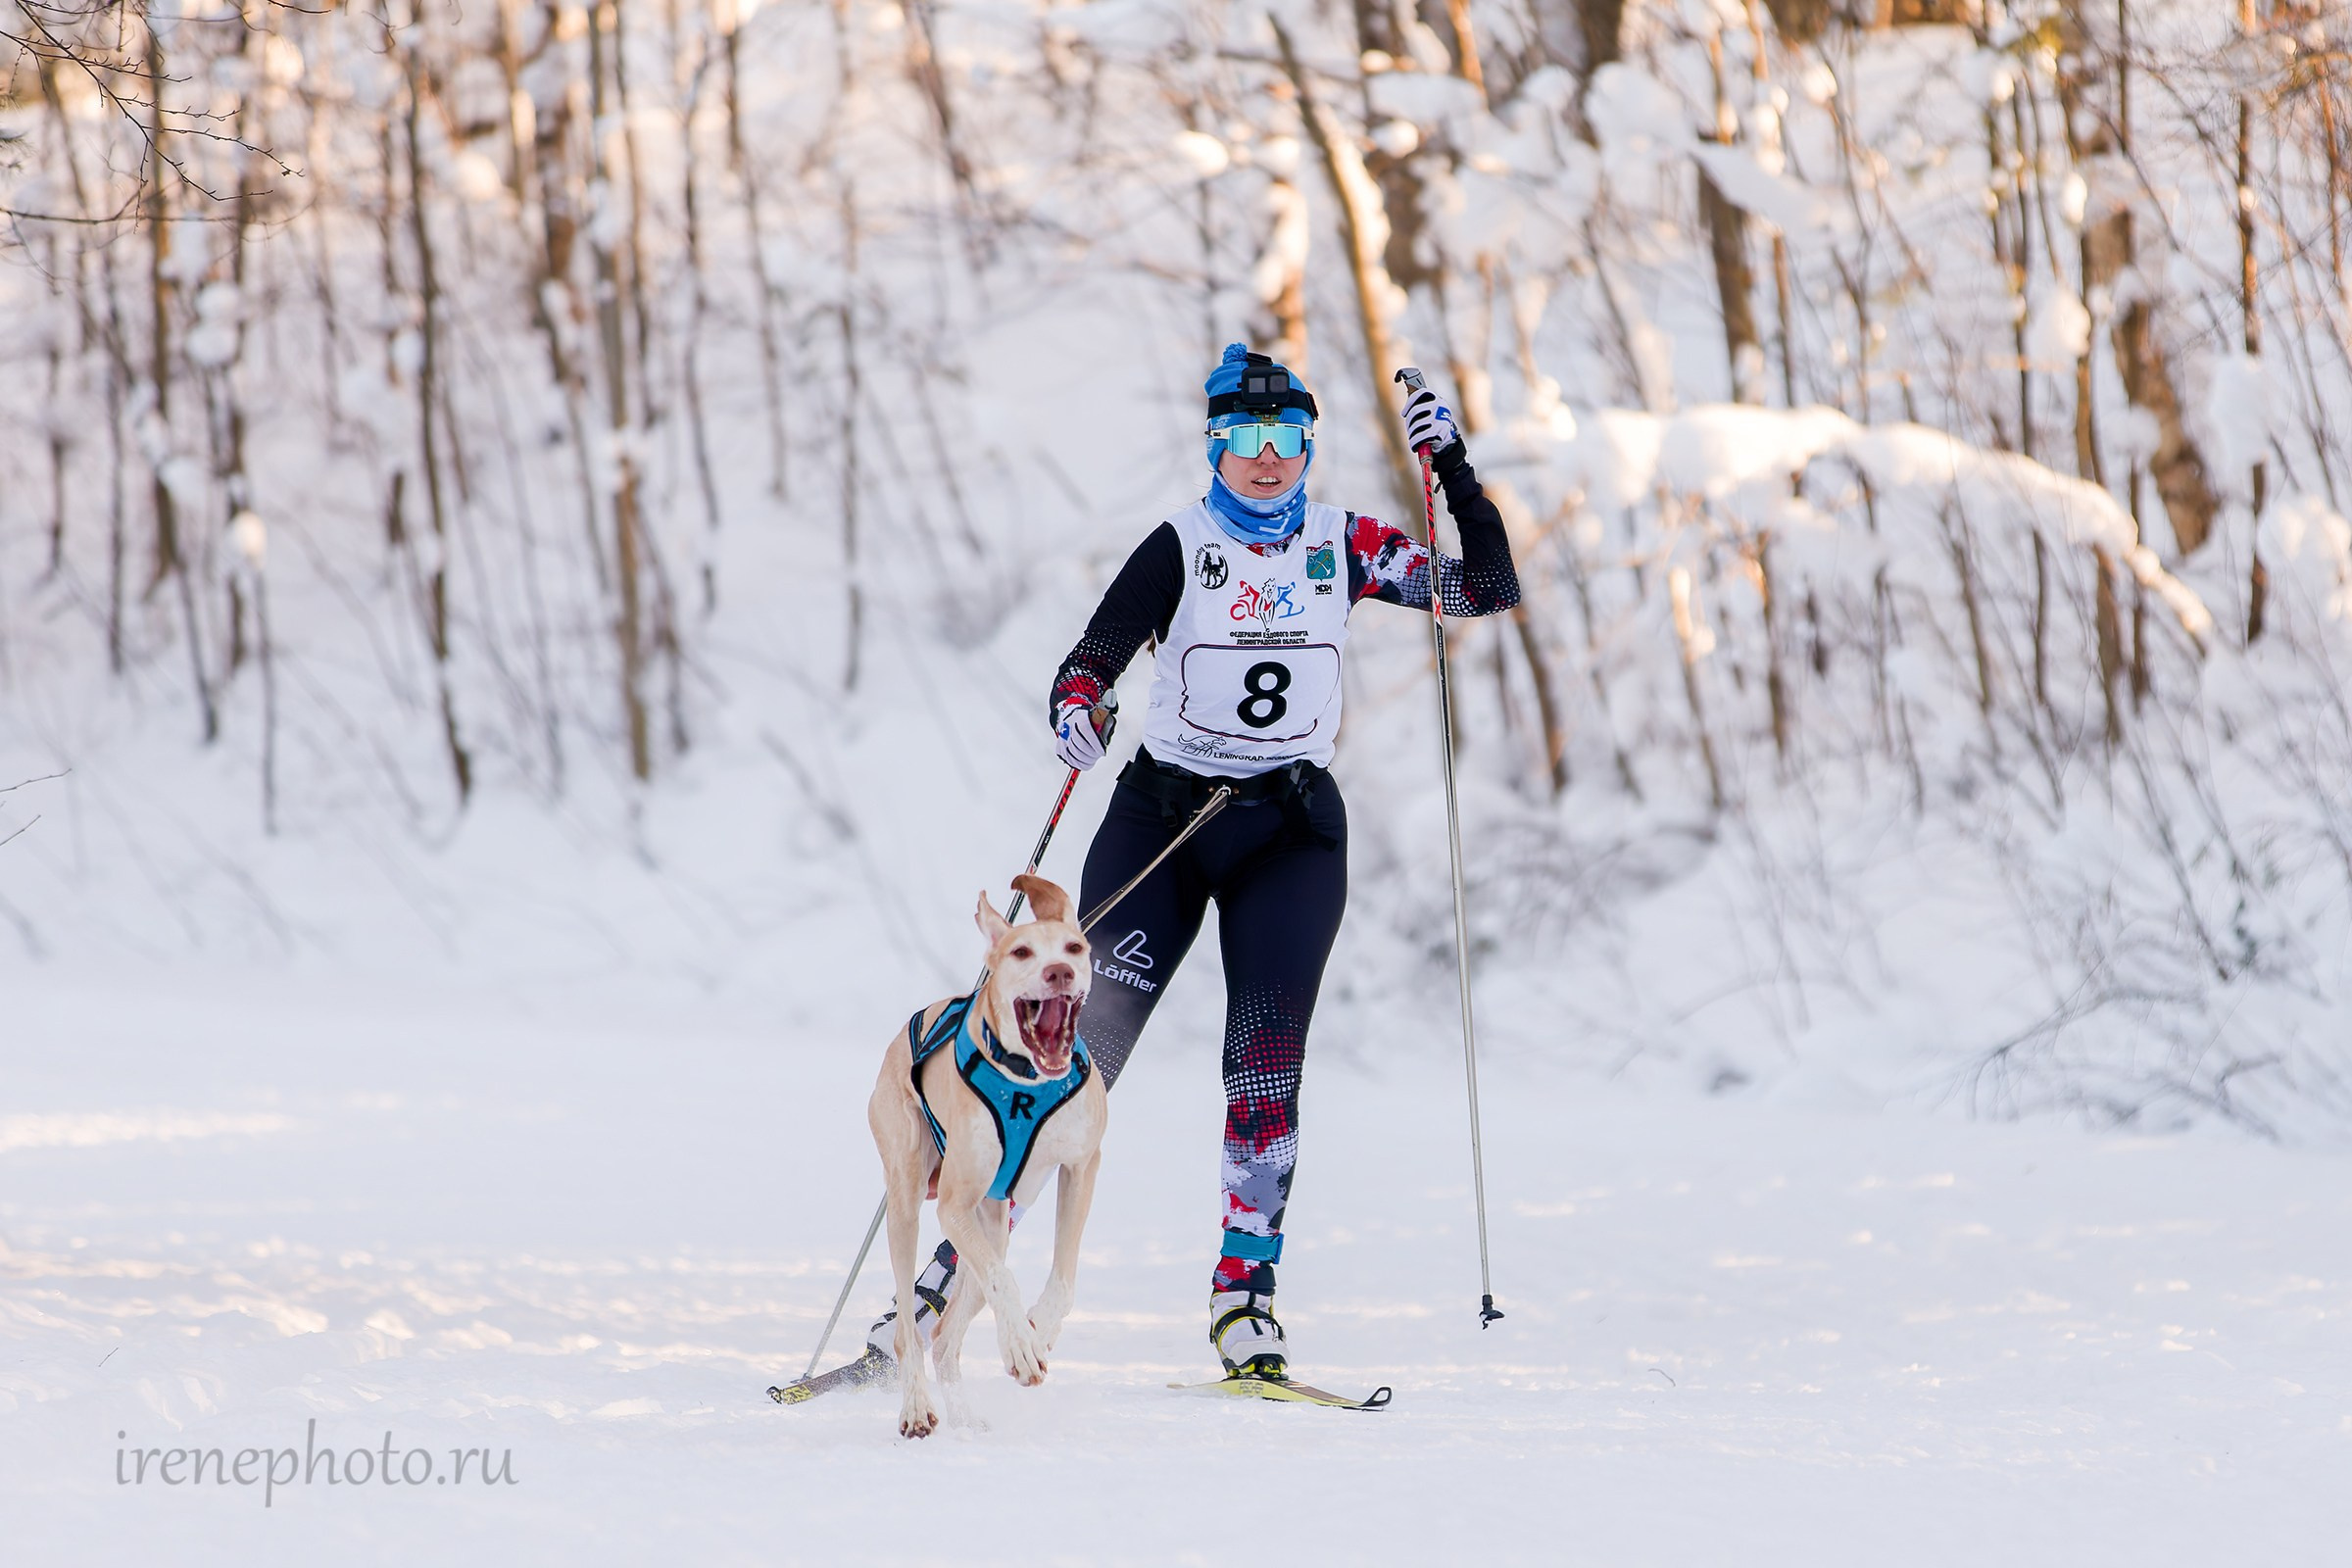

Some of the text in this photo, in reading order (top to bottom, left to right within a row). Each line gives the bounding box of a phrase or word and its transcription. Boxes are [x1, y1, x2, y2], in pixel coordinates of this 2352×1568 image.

[1237, 662, 1292, 728] 8
[1093, 958, 1157, 993] Löffler
[1009, 1091, 1036, 1120] R
